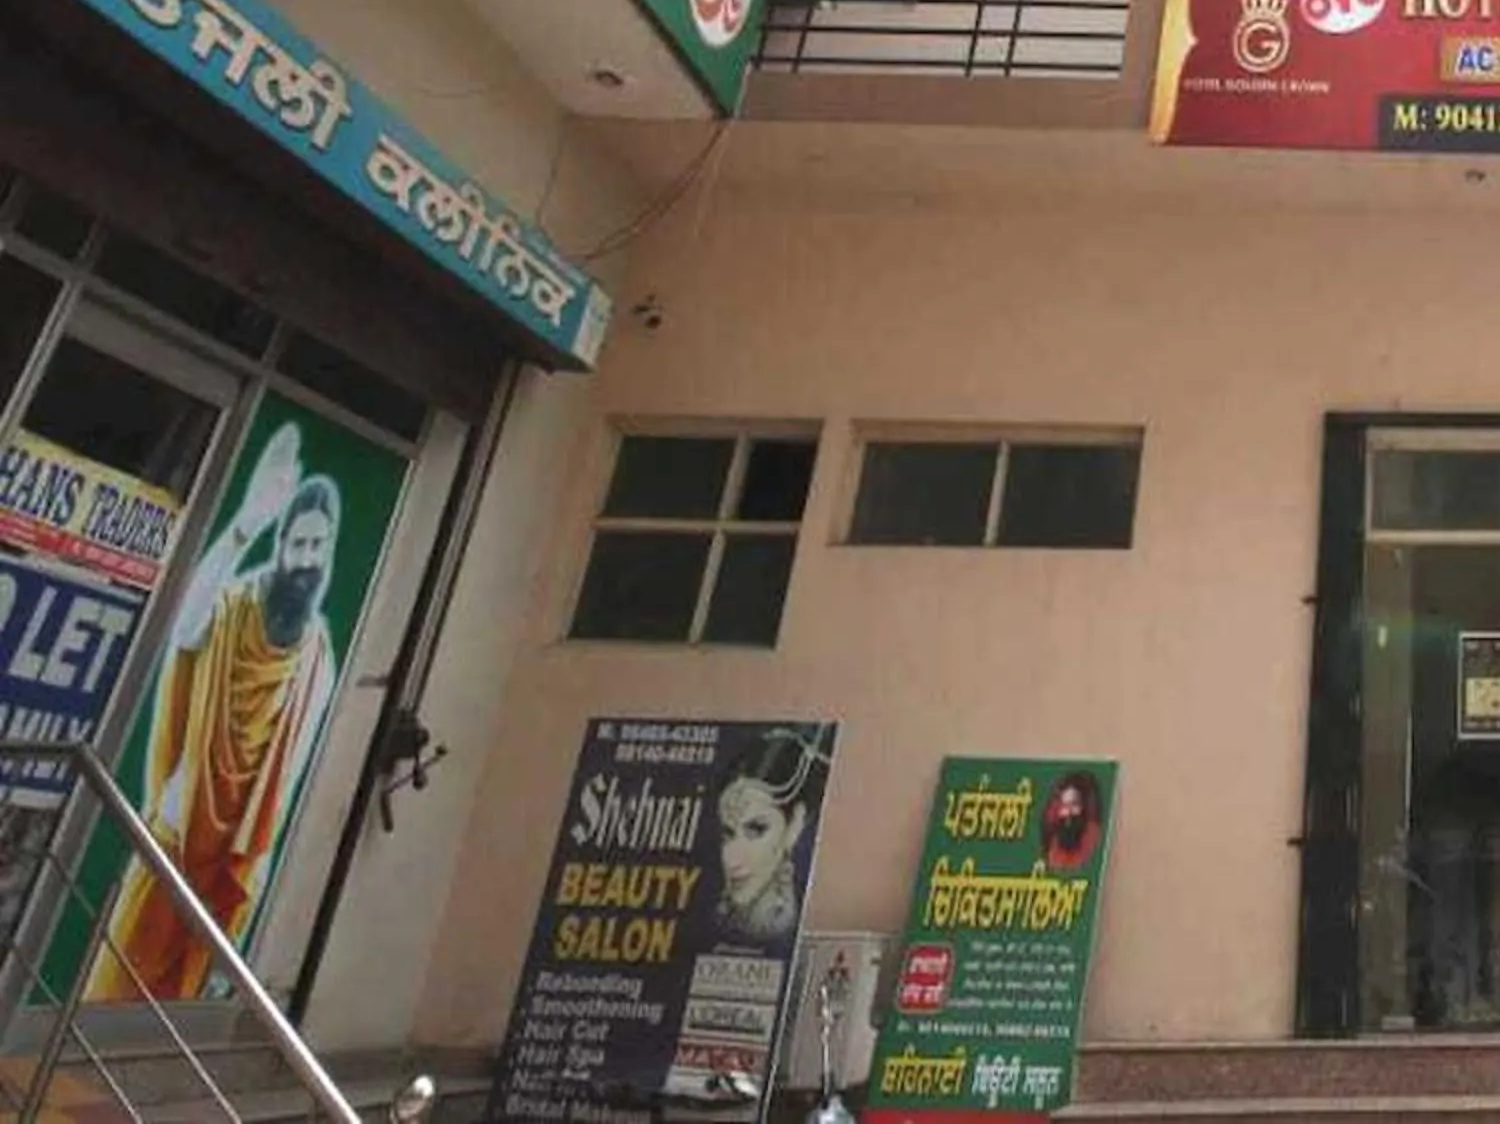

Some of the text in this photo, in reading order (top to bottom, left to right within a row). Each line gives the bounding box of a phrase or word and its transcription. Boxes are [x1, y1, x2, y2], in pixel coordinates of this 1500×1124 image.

[1457, 47, 1495, 74] AC
[1394, 104, 1428, 130] M:
[365, 132, 577, 326] ਕਲੀਨਿਕ
[8, 584, 136, 694] LET
[571, 772, 705, 853] Shehnai
[943, 774, 1034, 841] ਪਤੰਜਲੀ
[556, 862, 702, 910] BEAUTY
[553, 914, 678, 963] SALON
